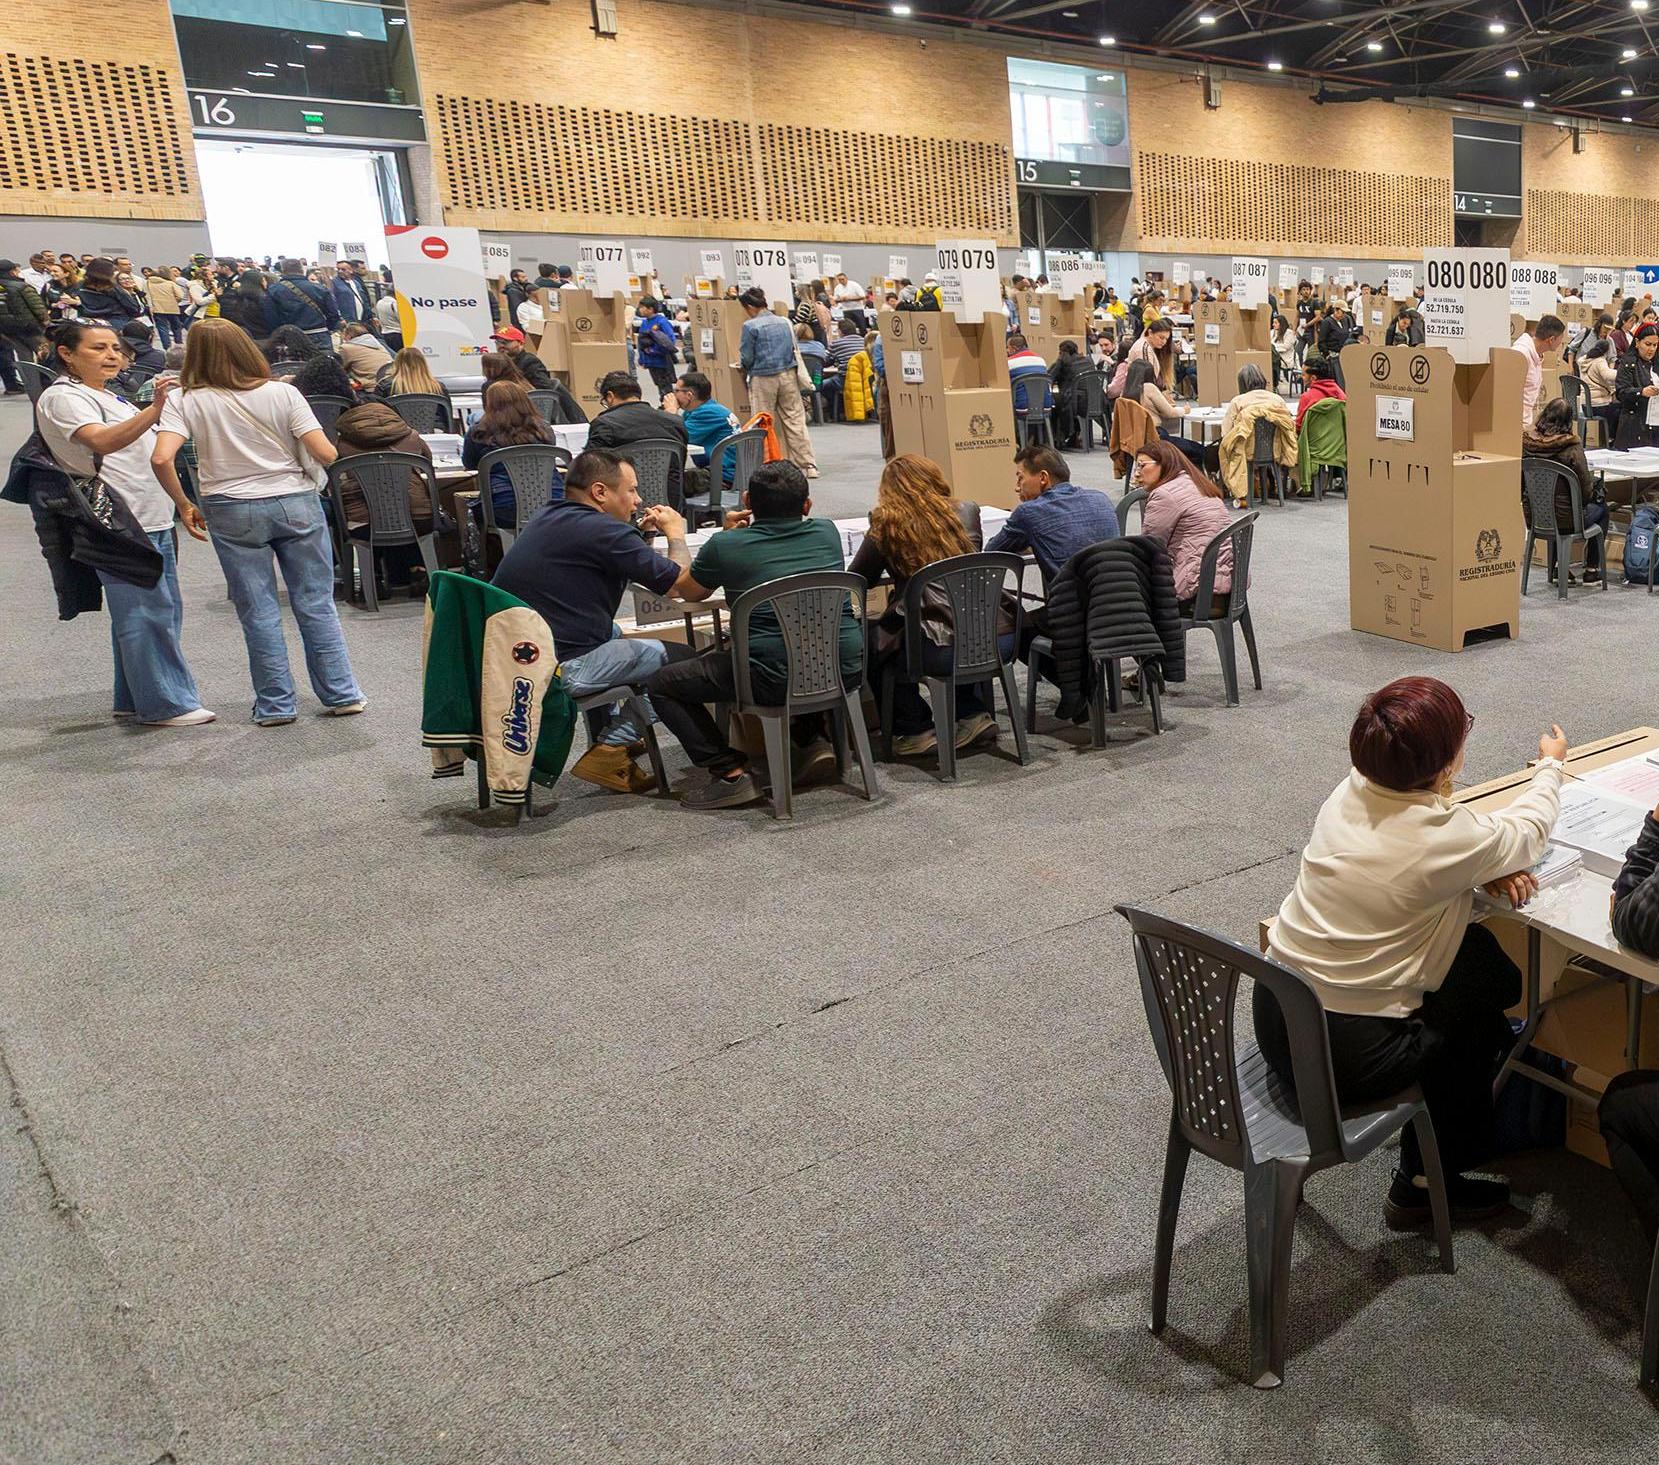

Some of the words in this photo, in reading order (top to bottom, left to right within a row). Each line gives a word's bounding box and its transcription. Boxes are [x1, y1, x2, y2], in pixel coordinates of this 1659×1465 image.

[194, 95, 236, 125] 16
[1017, 161, 1037, 182] 15
[1454, 195, 1466, 211] 14
[489, 247, 509, 257] 085
[596, 247, 623, 262] 077
[706, 254, 721, 262] 093
[735, 249, 750, 267] 078
[753, 250, 786, 266] 078
[802, 255, 817, 264] 094
[938, 249, 958, 269] 079
[962, 249, 995, 269] 079
[1061, 260, 1079, 271] 086
[1233, 263, 1246, 276] 087
[1248, 265, 1267, 277] 087
[1400, 269, 1412, 279] 095
[1428, 260, 1465, 288] 080
[1470, 261, 1506, 289] 080
[1511, 268, 1531, 283] 088
[1534, 269, 1557, 285] 088
[410, 297, 434, 308] No
[440, 298, 477, 309] pase
[1426, 303, 1464, 314] 52.719.750
[1426, 325, 1464, 335] 52.721.637
[904, 367, 915, 375] MESA
[1380, 418, 1400, 430] MESA
[1401, 420, 1410, 431] 80
[1459, 560, 1516, 577] REGISTRADURÍA
[502, 678, 533, 754] Universe
